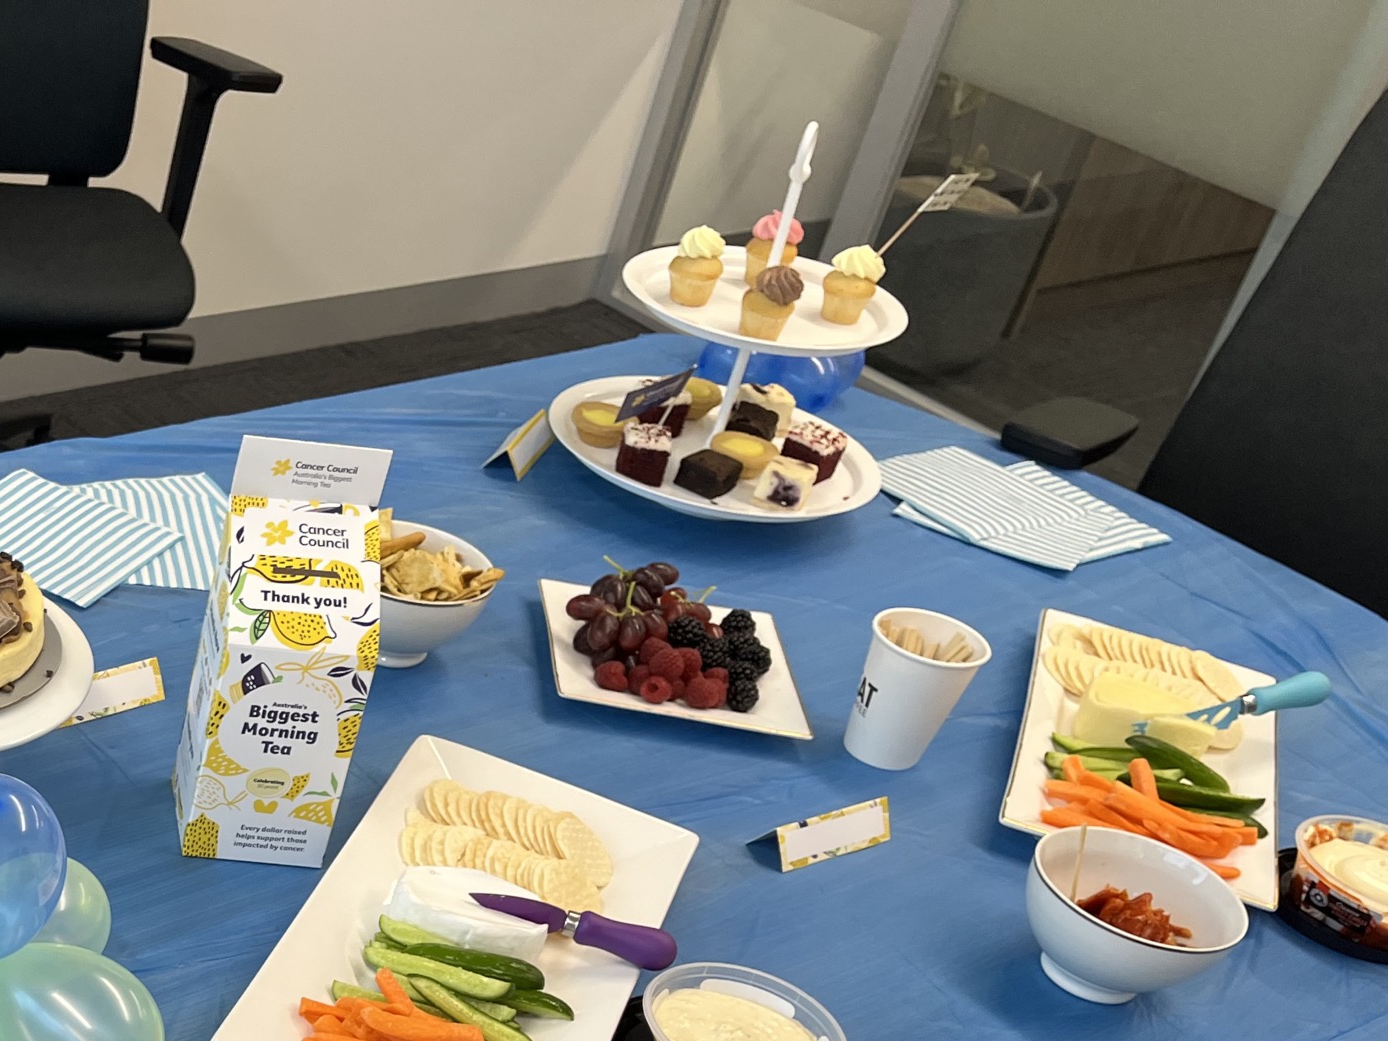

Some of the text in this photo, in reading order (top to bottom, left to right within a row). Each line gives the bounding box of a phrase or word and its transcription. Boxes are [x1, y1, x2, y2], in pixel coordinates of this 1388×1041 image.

[295, 461, 359, 475] Cancer Council
[298, 523, 347, 537] Cancer
[298, 535, 350, 549] Council
[260, 589, 348, 610] Thank you!
[272, 702, 308, 710] Australia's
[248, 704, 320, 725] Biggest
[240, 721, 319, 745] Morning
[261, 740, 293, 756] Tea
[240, 824, 307, 836] Every dollar raised
[235, 832, 256, 840] helps
[256, 834, 285, 843] support
[233, 841, 269, 850] impacted
[269, 843, 279, 852] by
